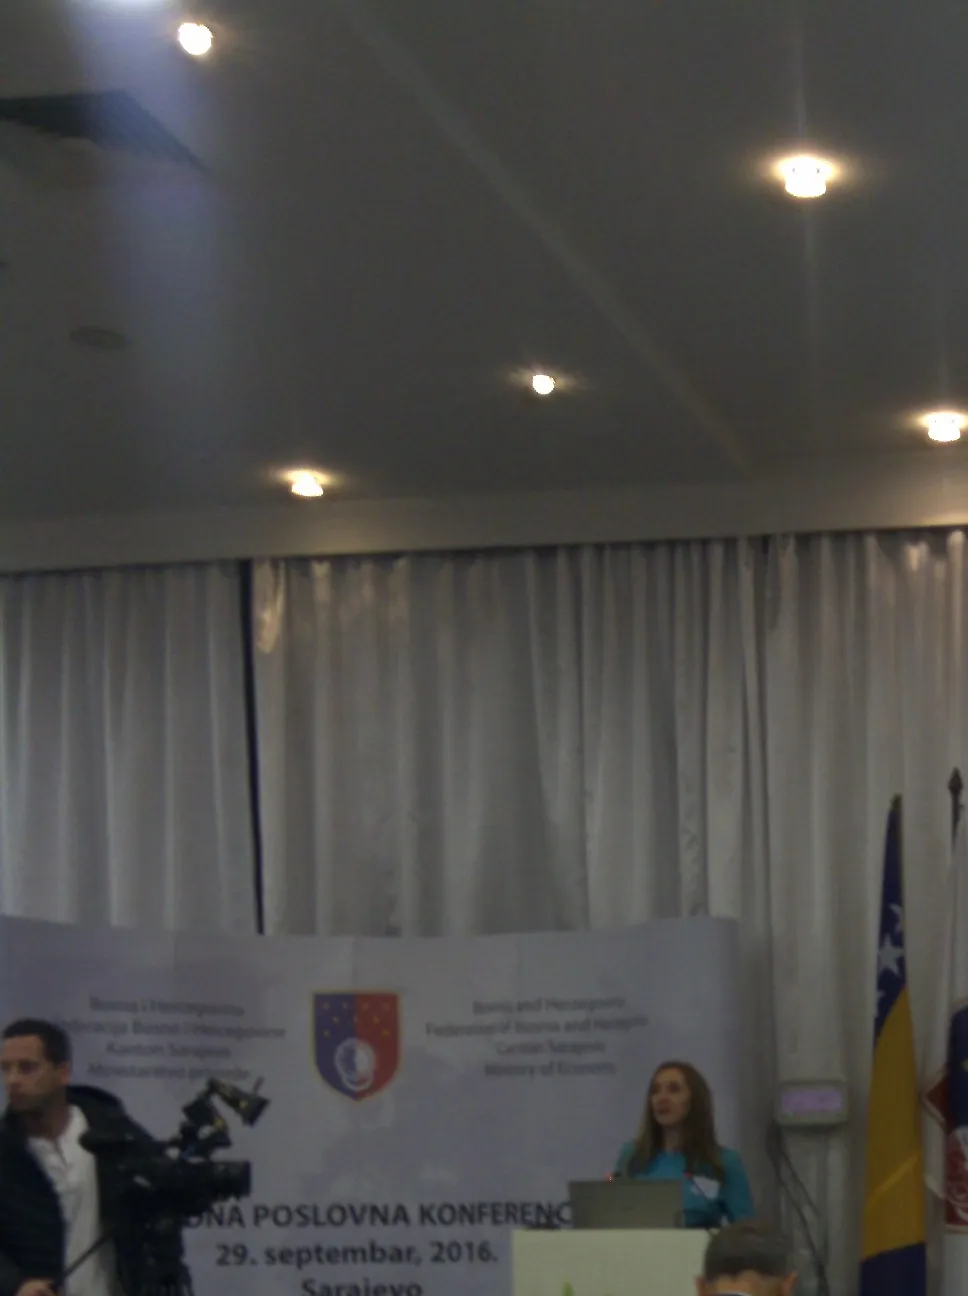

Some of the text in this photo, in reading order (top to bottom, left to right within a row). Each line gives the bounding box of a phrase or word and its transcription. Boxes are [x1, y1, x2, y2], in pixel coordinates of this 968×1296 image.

[253, 1202, 411, 1229] POSLOVNA
[419, 1201, 574, 1226] KONFERENC
[215, 1240, 500, 1270] 29. septembar, 2016.
